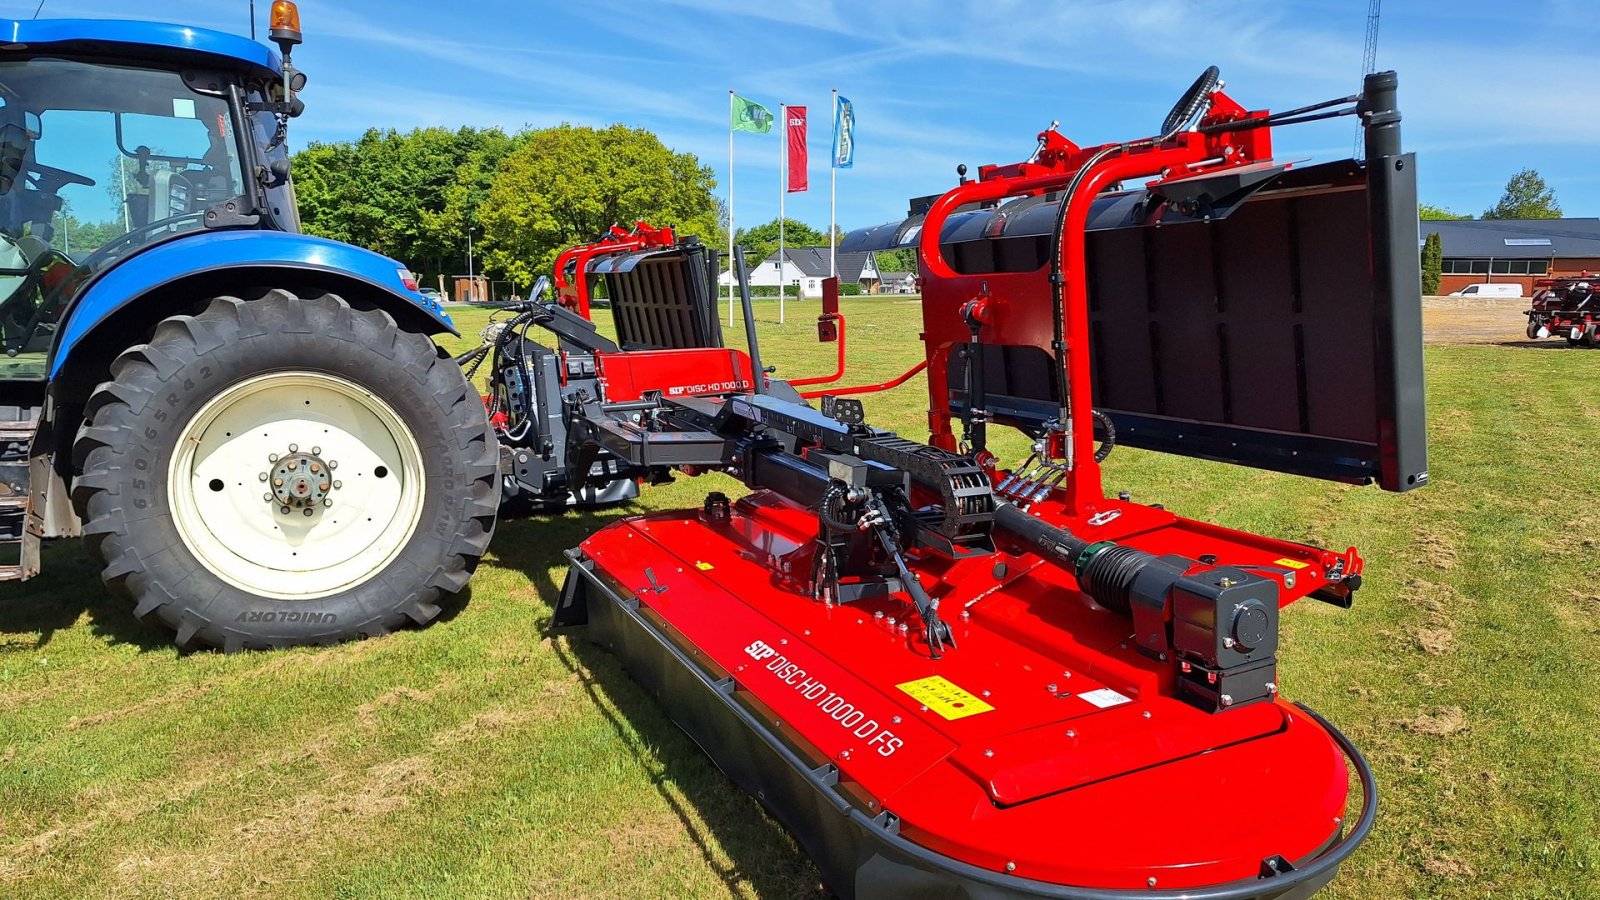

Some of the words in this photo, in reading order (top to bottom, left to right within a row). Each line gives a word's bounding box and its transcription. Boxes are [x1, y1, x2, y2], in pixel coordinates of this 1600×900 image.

[668, 386, 684, 395] SIP
[686, 384, 707, 393] DISC
[707, 382, 720, 391] HD
[720, 380, 741, 390] 1000
[742, 380, 749, 388] D
[234, 611, 338, 624] UNIGLORY
[744, 640, 776, 661] SIP
[766, 656, 807, 686] DISC
[794, 676, 828, 701] HD
[816, 692, 865, 729] 1000
[853, 719, 879, 739] D
[867, 729, 904, 757] FS
